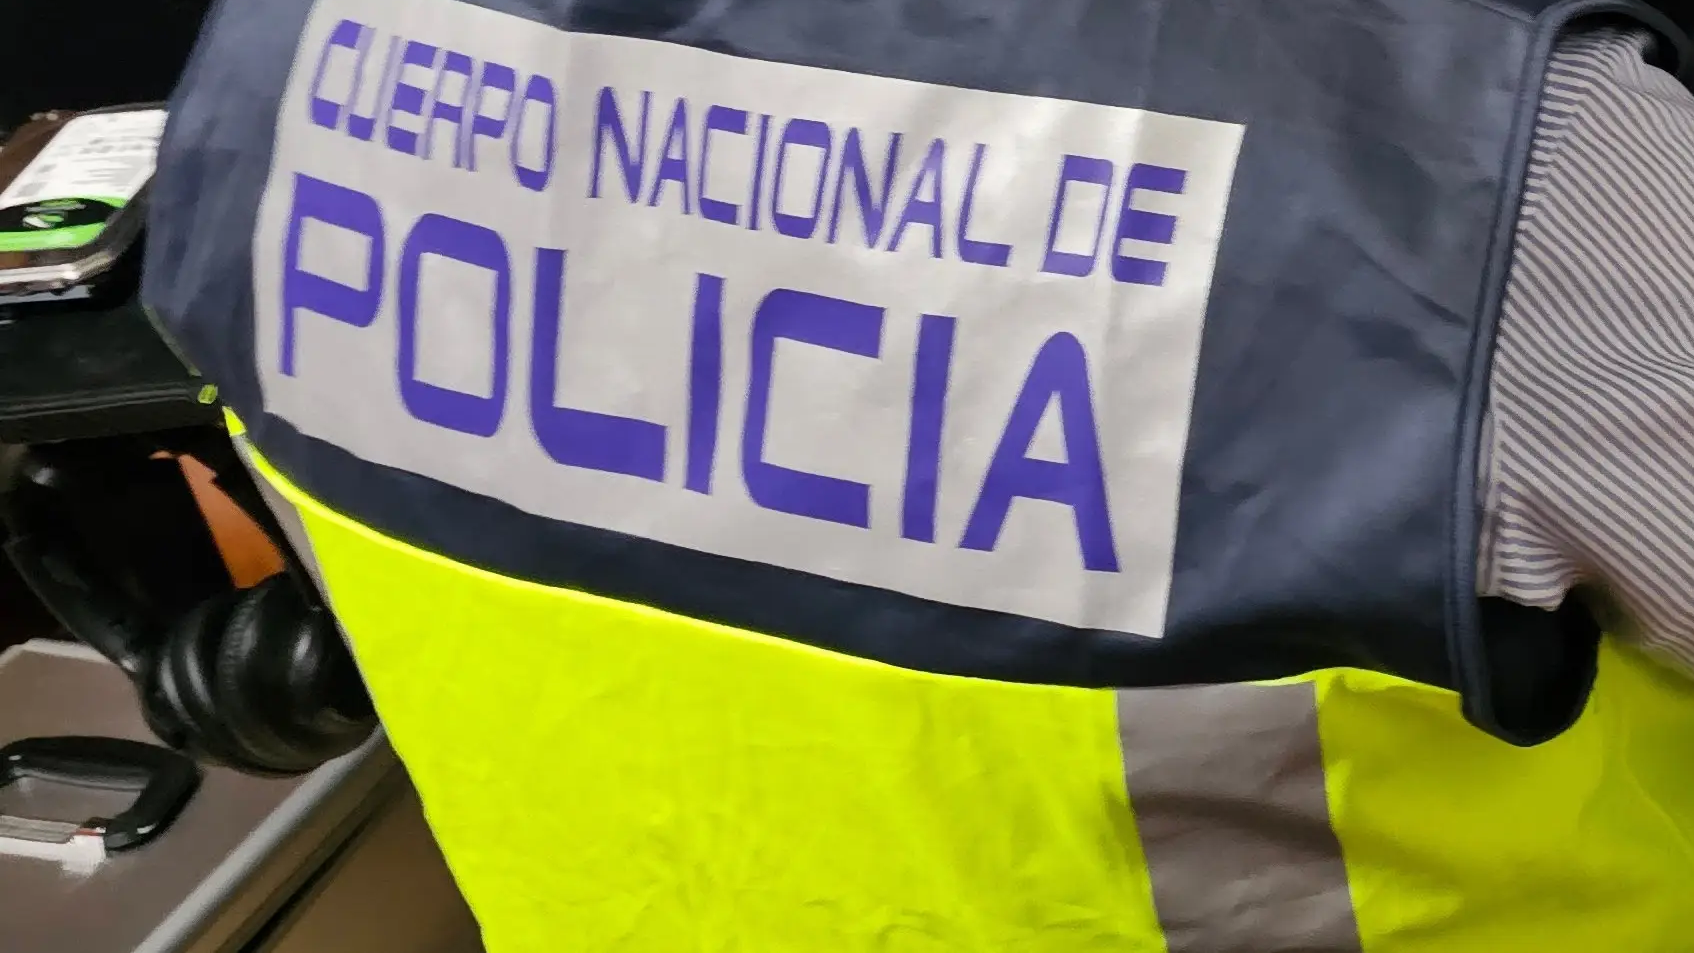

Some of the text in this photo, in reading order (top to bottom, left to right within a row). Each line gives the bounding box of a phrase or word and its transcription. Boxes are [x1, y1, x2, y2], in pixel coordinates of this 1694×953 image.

[308, 17, 557, 193] CUERPO
[588, 84, 1012, 268] NACIONAL
[1038, 152, 1187, 287] DE
[279, 172, 1122, 574] POLICIA
